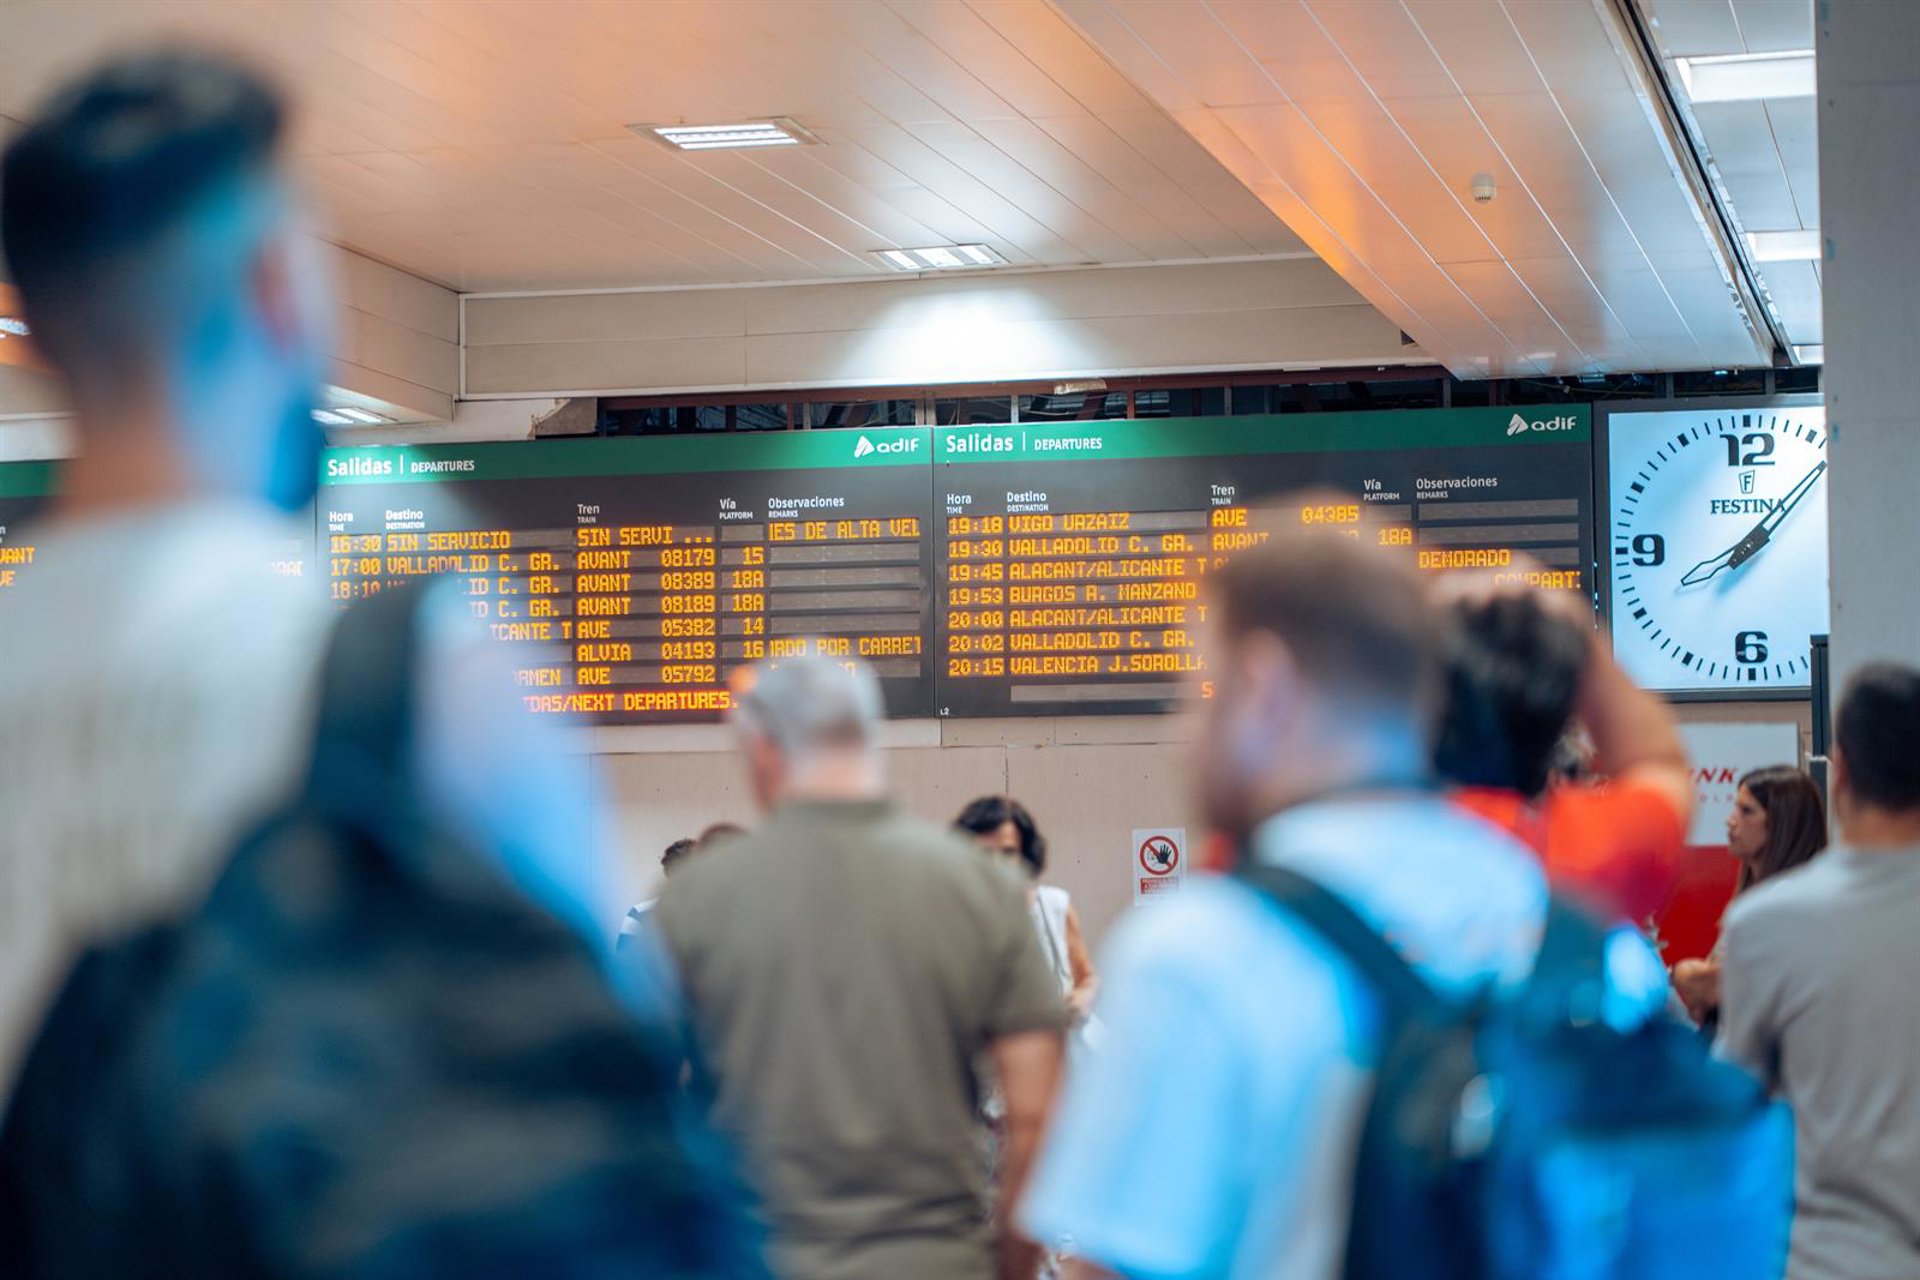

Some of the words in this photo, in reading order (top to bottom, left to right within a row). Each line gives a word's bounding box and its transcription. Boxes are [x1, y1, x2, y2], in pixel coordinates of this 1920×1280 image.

[1531, 416, 1577, 431] adif
[877, 438, 920, 453] adif
[947, 434, 1013, 452] Salidas
[1034, 438, 1102, 451] DEPARTURES
[1720, 432, 1775, 466] 12
[328, 457, 392, 476] Salidas
[411, 460, 474, 473] DEPARTURES
[1211, 485, 1235, 496] Tren
[1364, 478, 1382, 491] Vía
[1416, 476, 1498, 490] Observaciones
[768, 496, 844, 509] Observaciones
[947, 493, 972, 505] Hora
[1007, 490, 1047, 502] Destino
[1364, 492, 1400, 501] PLATFORM
[1416, 490, 1448, 499] REMARKS
[578, 504, 599, 514] Tren
[720, 499, 736, 509] Vía
[1007, 503, 1049, 512] DESTINATION
[1710, 498, 1786, 514] FESTINA
[329, 511, 353, 522] Hora
[385, 508, 423, 520] Destino
[578, 516, 596, 524] TRAIN
[720, 511, 753, 520] PLATFORM
[768, 510, 798, 519] REMARKS
[1213, 509, 1248, 527] AVE
[1302, 505, 1359, 524] 04385
[329, 523, 344, 531] TIME
[385, 521, 425, 530] DESTINATION
[805, 521, 827, 540] DE
[837, 520, 880, 538] ALTA
[890, 518, 920, 536] VEL
[1009, 515, 1053, 533] VIGO
[331, 535, 381, 553] 16:30
[387, 534, 418, 552] SIN
[427, 531, 511, 551] SERVICIO
[578, 528, 610, 547] SIN
[620, 526, 672, 545] SERVI
[1009, 536, 1119, 556] VALLADOLID
[1129, 536, 1149, 553] C.
[1162, 535, 1193, 552] GR.
[1213, 531, 1269, 550] AVANT
[1379, 528, 1412, 545] 18A
[743, 547, 764, 565] 15
[949, 540, 1002, 558] 19:30
[1632, 534, 1665, 566] 9
[331, 557, 381, 576] 17:00
[387, 554, 489, 575] VALLADOLID
[499, 554, 518, 572] C.
[530, 553, 560, 571] GR.
[578, 551, 631, 569] AVANT
[661, 548, 715, 567] 08179
[1419, 549, 1510, 568] DEMORADO
[949, 564, 1002, 582] 19:45
[1009, 558, 1185, 580] ALACANT/ALICANTE
[499, 577, 518, 595] C.
[529, 575, 559, 594] GR.
[578, 574, 631, 593] AVANT
[661, 572, 715, 590] 08389
[732, 571, 764, 589] 18A
[949, 588, 1002, 606] 19:53
[1010, 586, 1075, 604] BURGOS
[1119, 582, 1196, 601] MANZANO
[499, 600, 517, 617] C.
[529, 599, 559, 617] GR.
[578, 597, 631, 615] AVANT
[661, 595, 715, 614] 08189
[732, 594, 764, 612] 18A
[949, 611, 1002, 630] 20:00
[1010, 606, 1185, 627] ALACANT/ALICANTE
[562, 621, 572, 639] T
[577, 620, 610, 639] AVE
[662, 618, 715, 637] 05382
[743, 617, 764, 635] 14
[817, 637, 850, 656] POR
[949, 634, 1003, 653] 20:02
[1010, 631, 1120, 650] VALLADOLID
[1130, 631, 1150, 648] C.
[1163, 630, 1194, 648] GR.
[1735, 631, 1768, 663] 6
[577, 643, 632, 662] ALVIA
[662, 641, 715, 660] 04193
[743, 641, 764, 658] 16
[949, 658, 1004, 676] 20:15
[1010, 655, 1099, 674] VALENCIA
[578, 667, 611, 685] AVE
[662, 665, 715, 683] 05792
